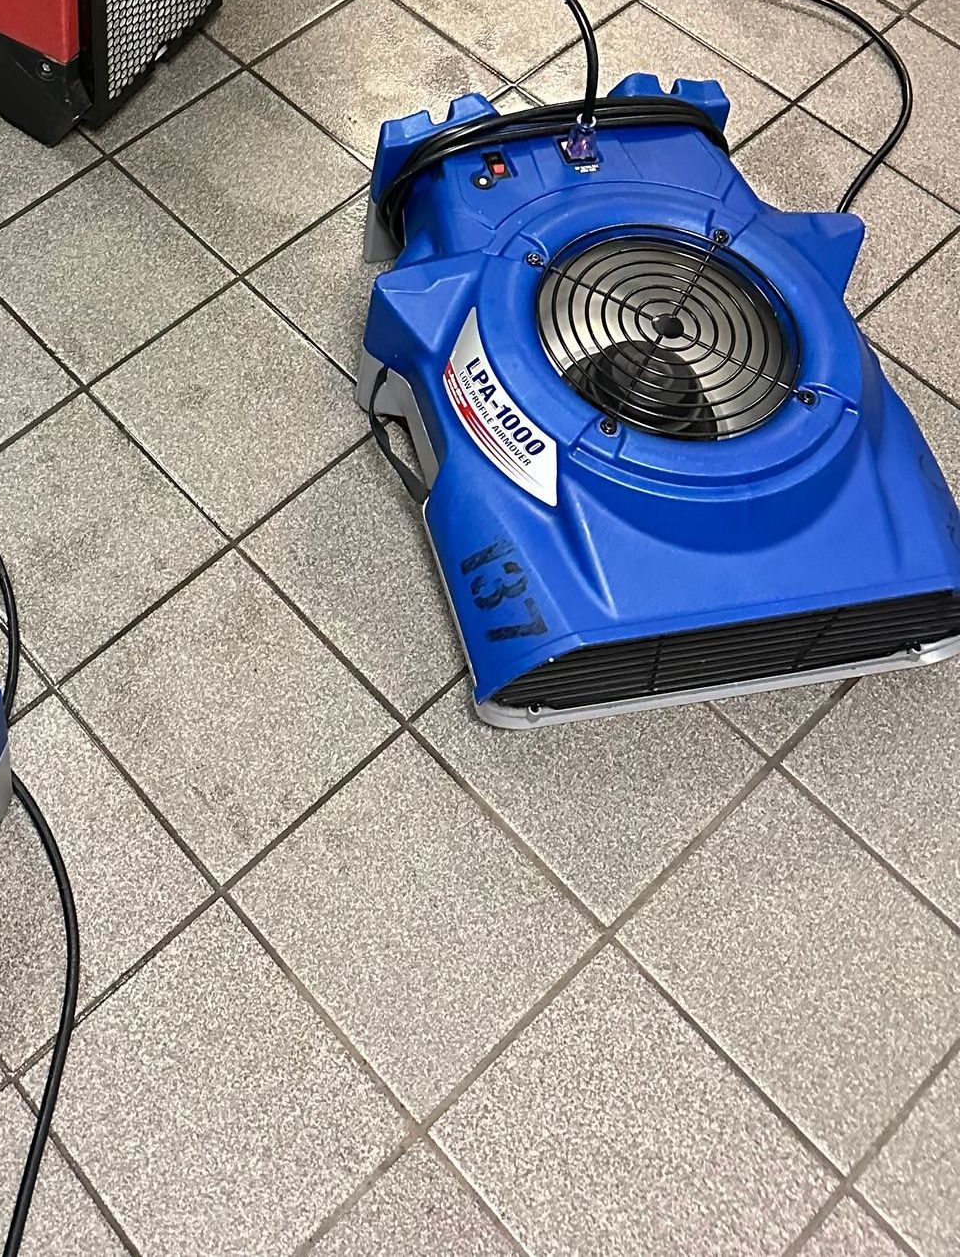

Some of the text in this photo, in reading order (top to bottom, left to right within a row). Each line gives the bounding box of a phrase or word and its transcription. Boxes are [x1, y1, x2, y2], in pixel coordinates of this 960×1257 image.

[459, 371, 533, 467] LOW PROFILE AIRMOVER
[466, 356, 546, 457] LPA-1000
